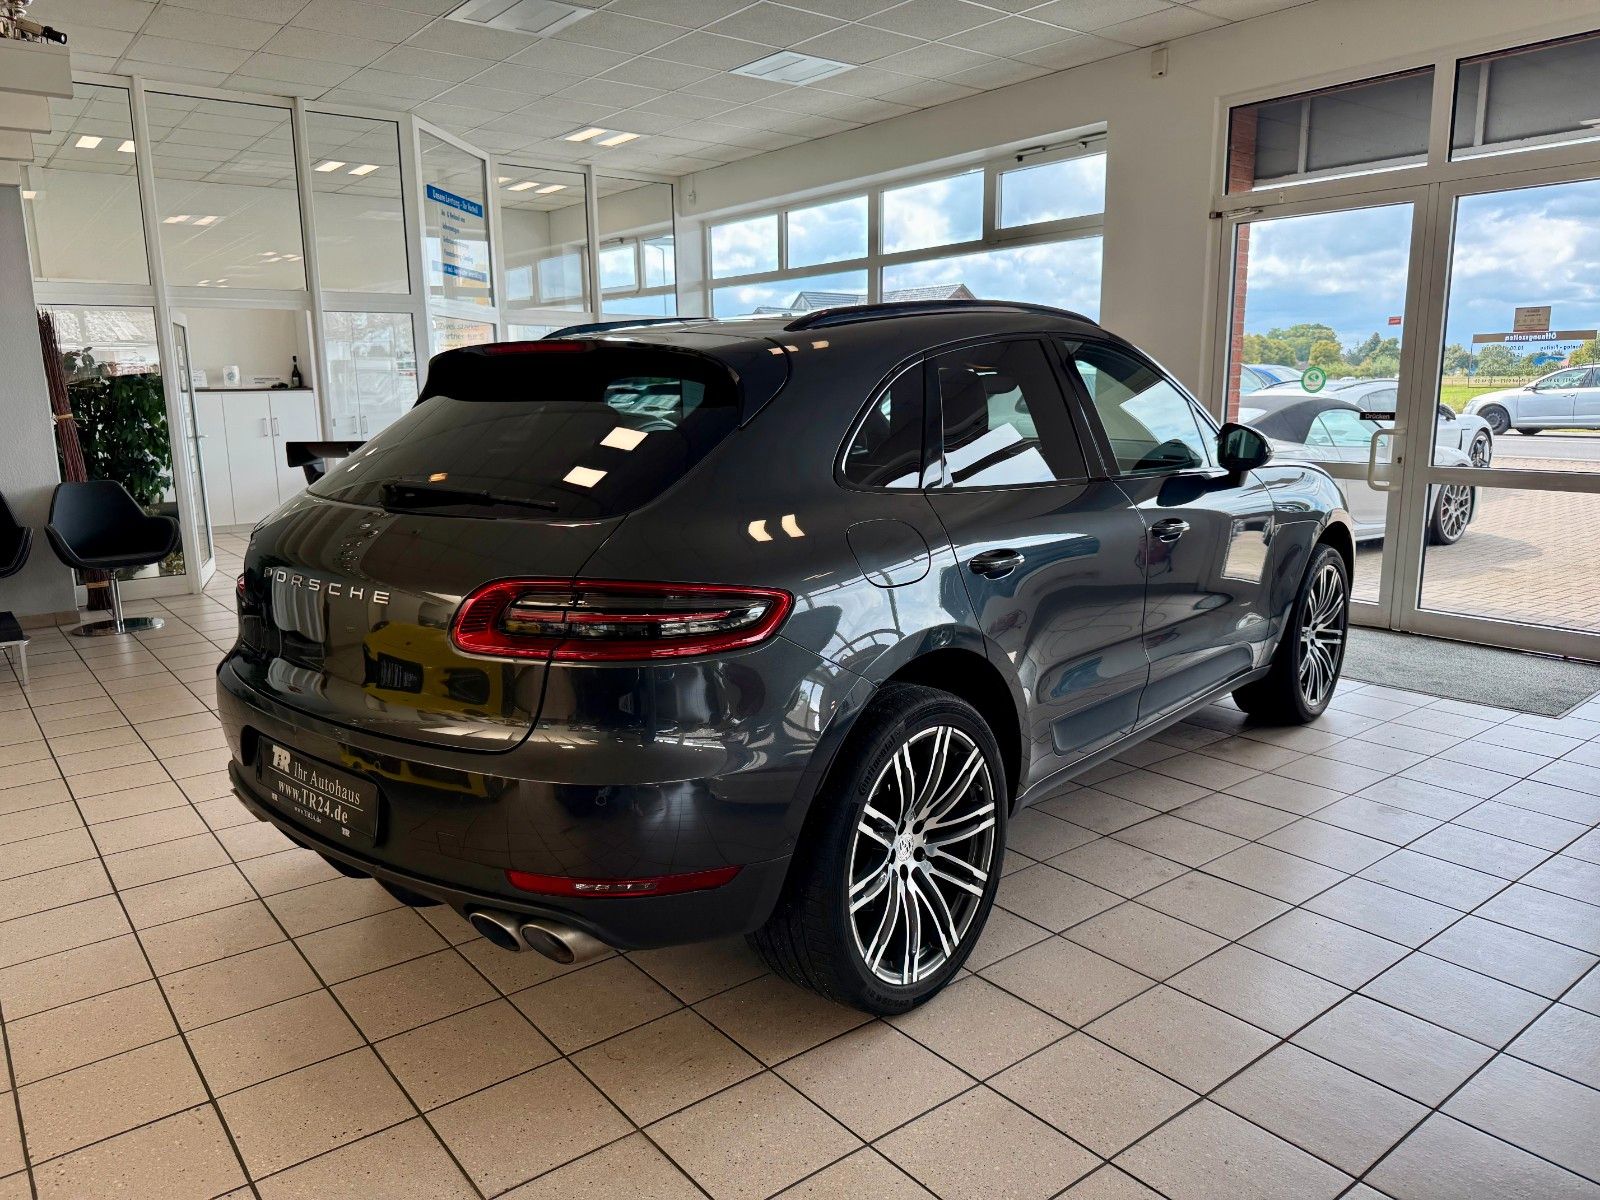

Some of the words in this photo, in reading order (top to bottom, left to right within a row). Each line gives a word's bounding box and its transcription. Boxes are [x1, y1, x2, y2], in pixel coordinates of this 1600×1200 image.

[263, 566, 390, 605] PORSCHE
[278, 780, 348, 824] www.TR24.de
[293, 762, 308, 781] Ihr
[310, 770, 360, 805] Autohaus
